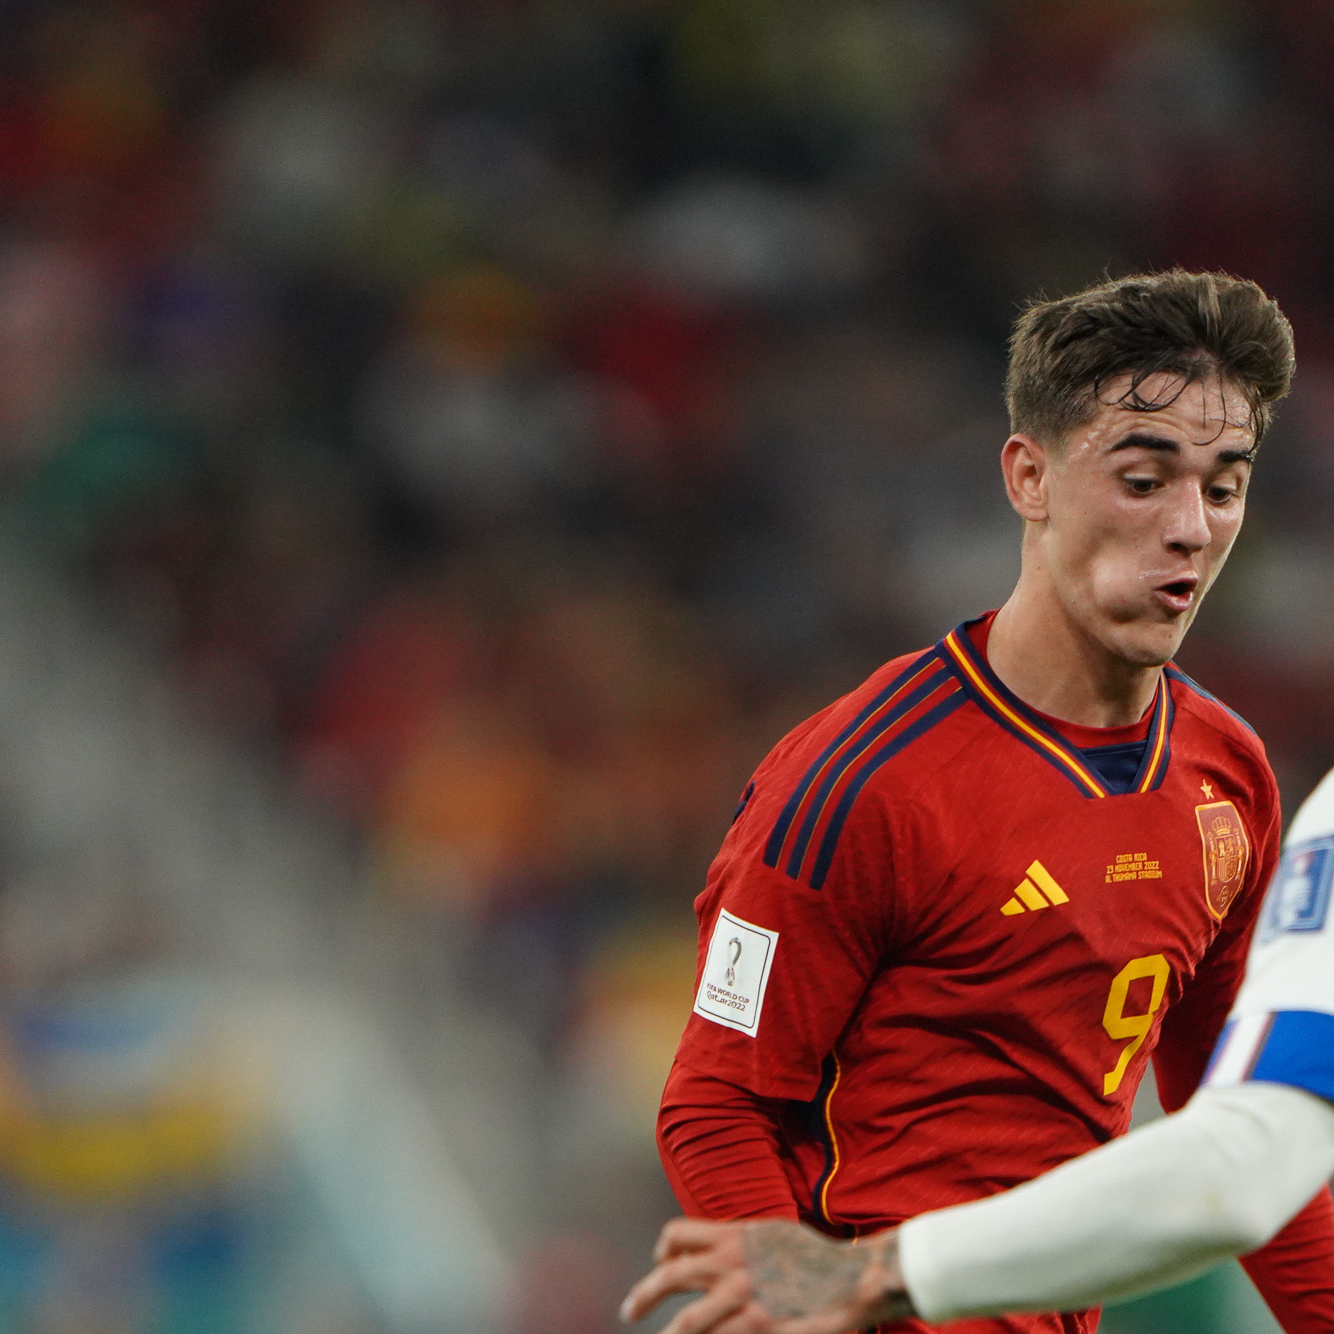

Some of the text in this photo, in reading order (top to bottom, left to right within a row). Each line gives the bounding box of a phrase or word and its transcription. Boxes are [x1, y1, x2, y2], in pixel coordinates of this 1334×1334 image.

[1116, 853, 1147, 863] COSTA RICA
[1107, 861, 1160, 874] 23 NOVEMBER 2022
[1138, 870, 1163, 879] STADIUM
[707, 983, 750, 1004] FIFA WORLD CUP
[1102, 953, 1171, 1097] 9
